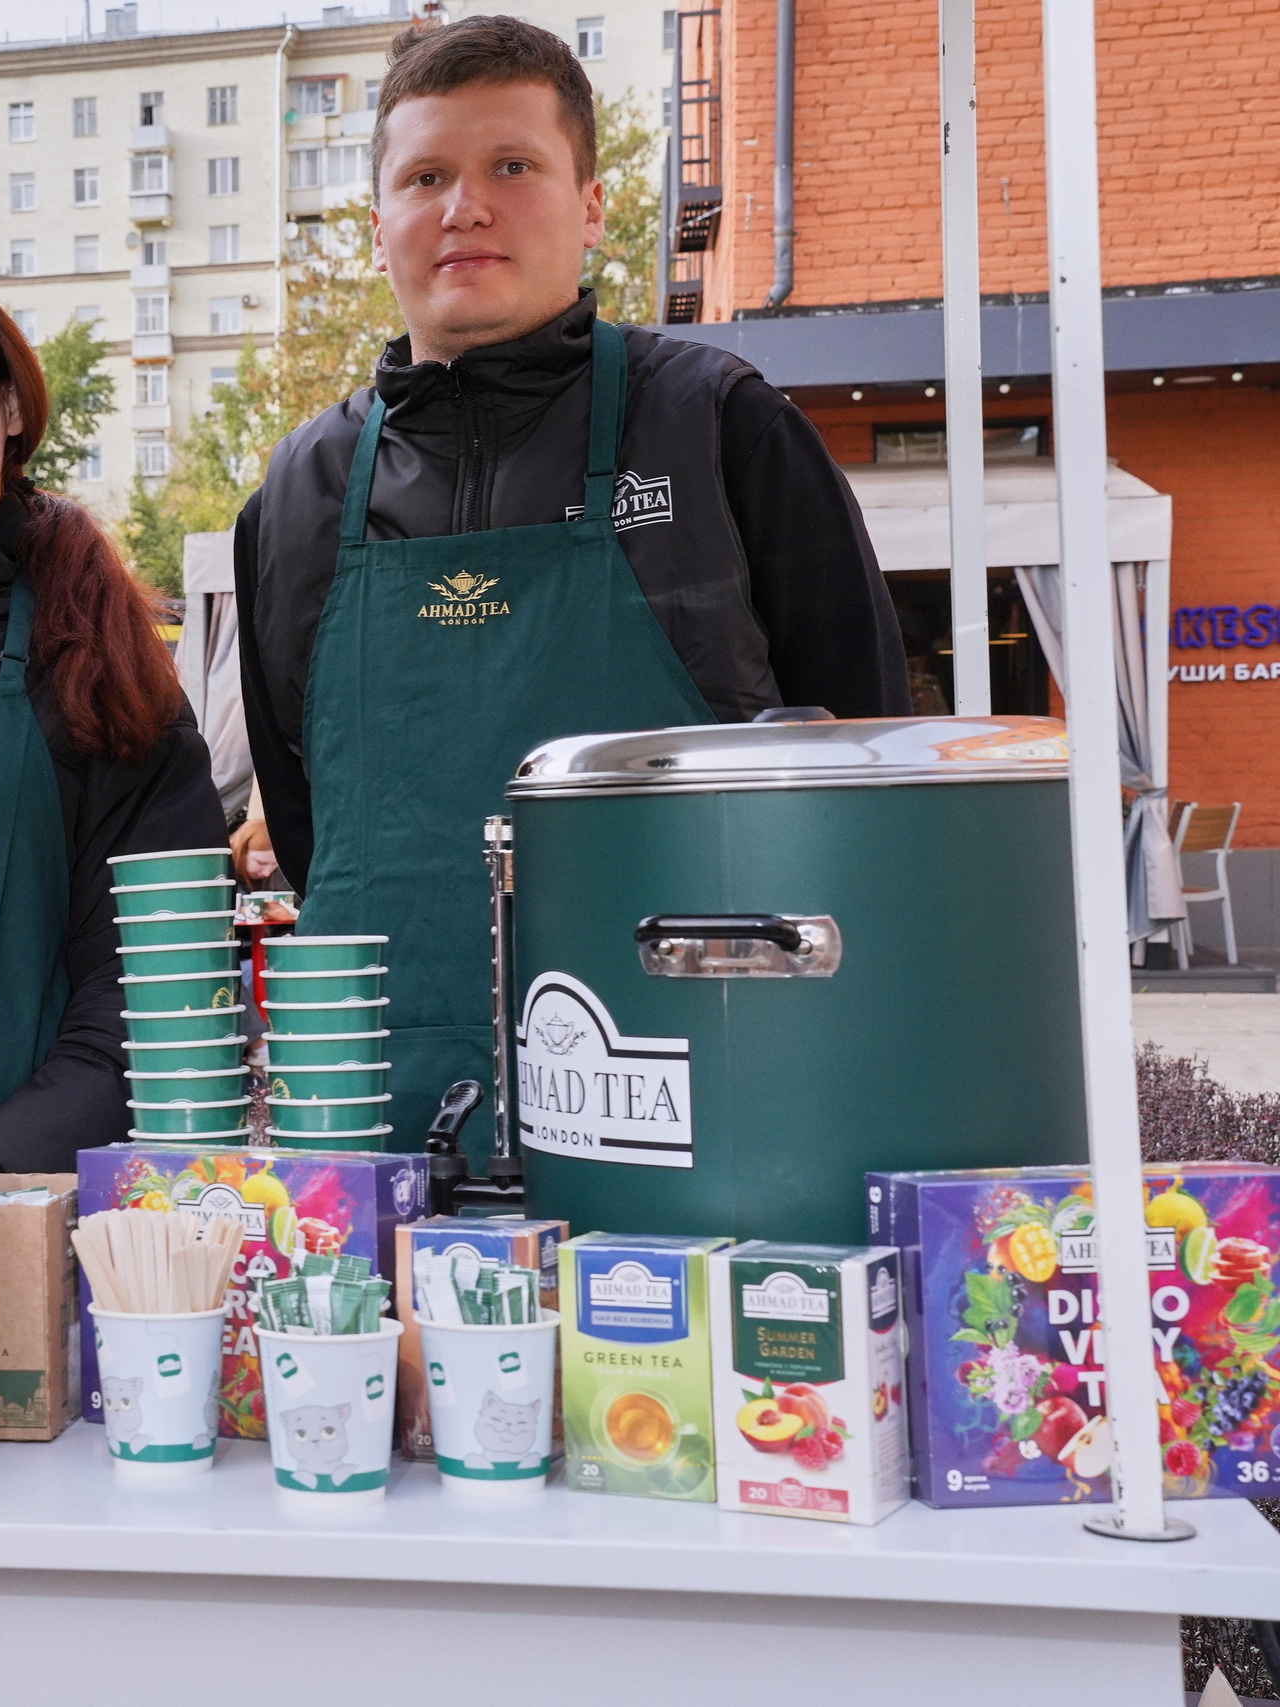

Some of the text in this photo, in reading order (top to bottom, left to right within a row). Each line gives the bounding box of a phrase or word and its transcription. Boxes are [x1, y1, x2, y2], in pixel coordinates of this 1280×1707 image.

[629, 489, 668, 512] TEA
[613, 517, 632, 527] DON
[417, 601, 511, 618] AHMAD TEA
[438, 618, 486, 626] LONDON
[1168, 604, 1280, 649] KES
[594, 1072, 682, 1123] TEA
[535, 1126, 593, 1147] LONDON
[1147, 1240, 1172, 1257] EA
[594, 1283, 669, 1298] AHMAD TEA
[747, 1295, 824, 1311] AHMAD TEA
[583, 1351, 683, 1368] GREEN TEA
[90, 1391, 102, 1409] 9
[416, 1434, 431, 1446] 20
[581, 1463, 599, 1476] 20
[1236, 1460, 1270, 1484] 36
[946, 1469, 963, 1492] 9
[747, 1486, 768, 1500] 20
